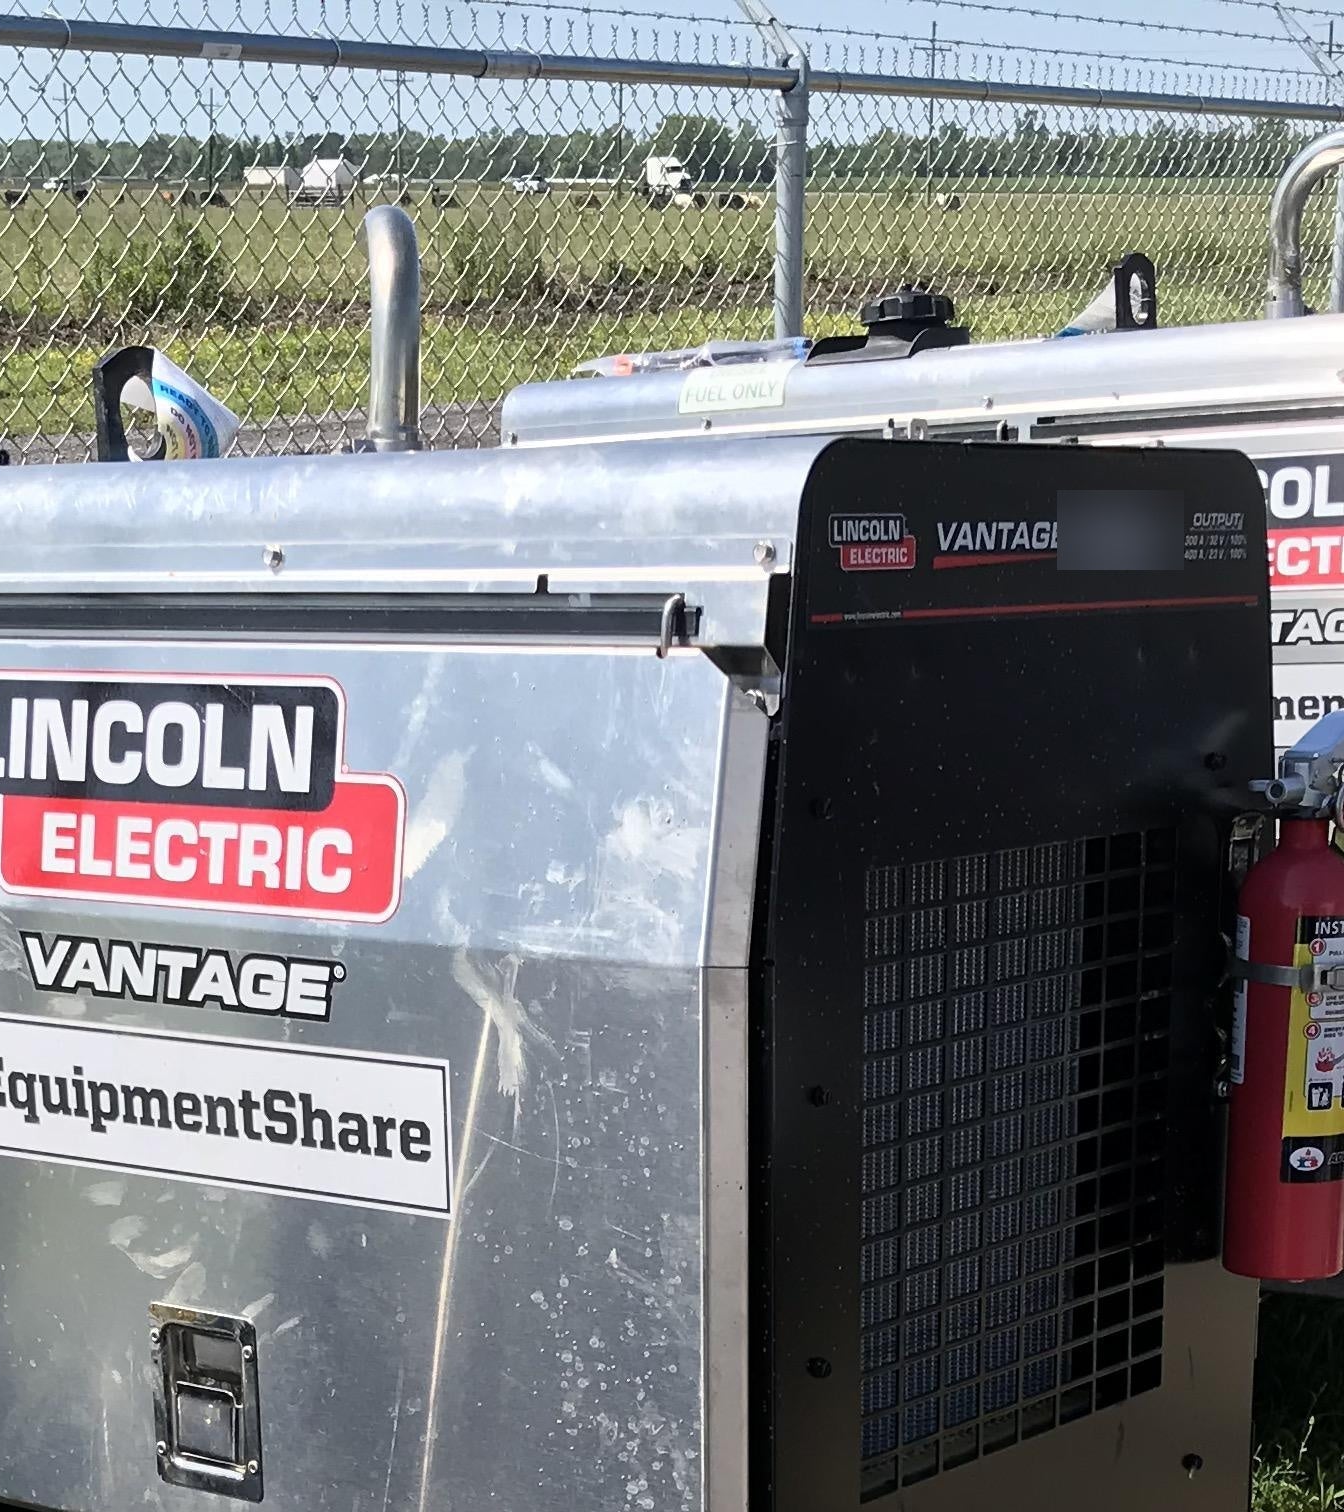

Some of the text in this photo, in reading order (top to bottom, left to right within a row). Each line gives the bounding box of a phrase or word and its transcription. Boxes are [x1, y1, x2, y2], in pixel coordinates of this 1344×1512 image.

[685, 381, 778, 403] FUEL ONLY
[159, 385, 210, 436] READY TO
[171, 407, 185, 425] DO
[833, 519, 901, 542] LINCOLN
[1193, 512, 1241, 527] OUTPUT
[850, 547, 908, 565] ELECTRIC
[40, 811, 354, 895] ELECTRIC
[20, 932, 336, 1021] VANTAGE
